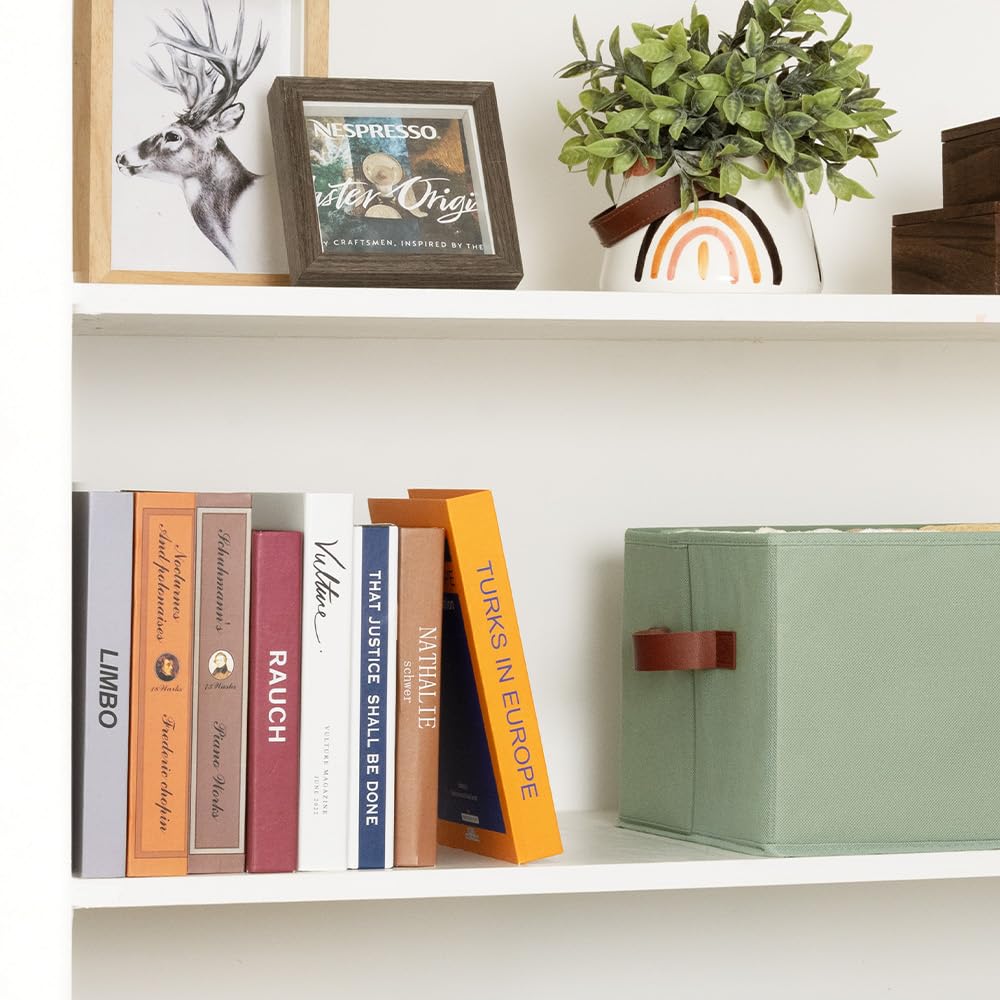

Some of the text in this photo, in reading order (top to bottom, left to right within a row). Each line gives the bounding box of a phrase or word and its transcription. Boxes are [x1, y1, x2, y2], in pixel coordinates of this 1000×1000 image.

[306, 119, 437, 141] NESPRESSO
[401, 240, 447, 249] INSPIRED
[451, 241, 463, 249] BY
[156, 523, 172, 562] And
[172, 544, 187, 620] Nocturnes
[98, 648, 119, 729] LIMBO
[268, 650, 288, 743] RAUCH
[365, 570, 382, 826] THAT JUSTICE SHALL BE DONE
[403, 660, 415, 704] schwer
[418, 626, 438, 729] NATHALIE
[476, 559, 539, 801] TURKS IN EUROPE
[155, 714, 176, 833] Frederic chopin
[210, 721, 227, 820] Piano Works
